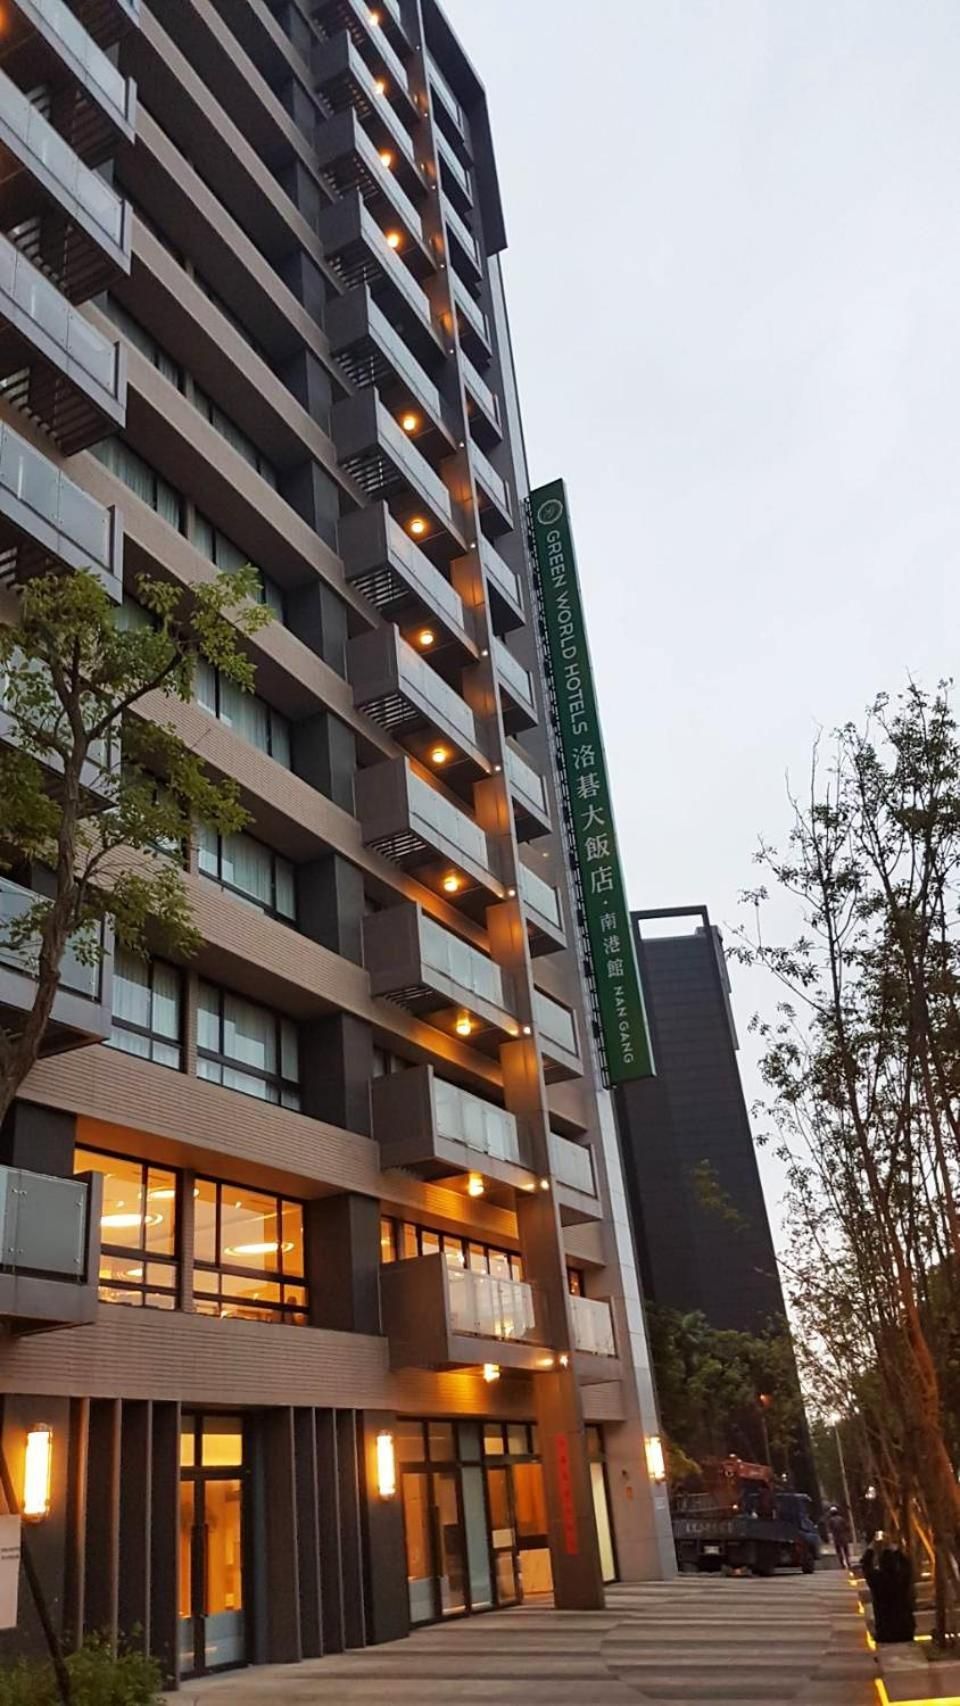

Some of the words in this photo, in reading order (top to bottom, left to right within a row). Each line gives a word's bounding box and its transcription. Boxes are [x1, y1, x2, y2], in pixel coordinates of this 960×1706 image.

[546, 530, 567, 588] GREEN
[554, 590, 577, 660] WORLD
[563, 664, 588, 736] HOTELS
